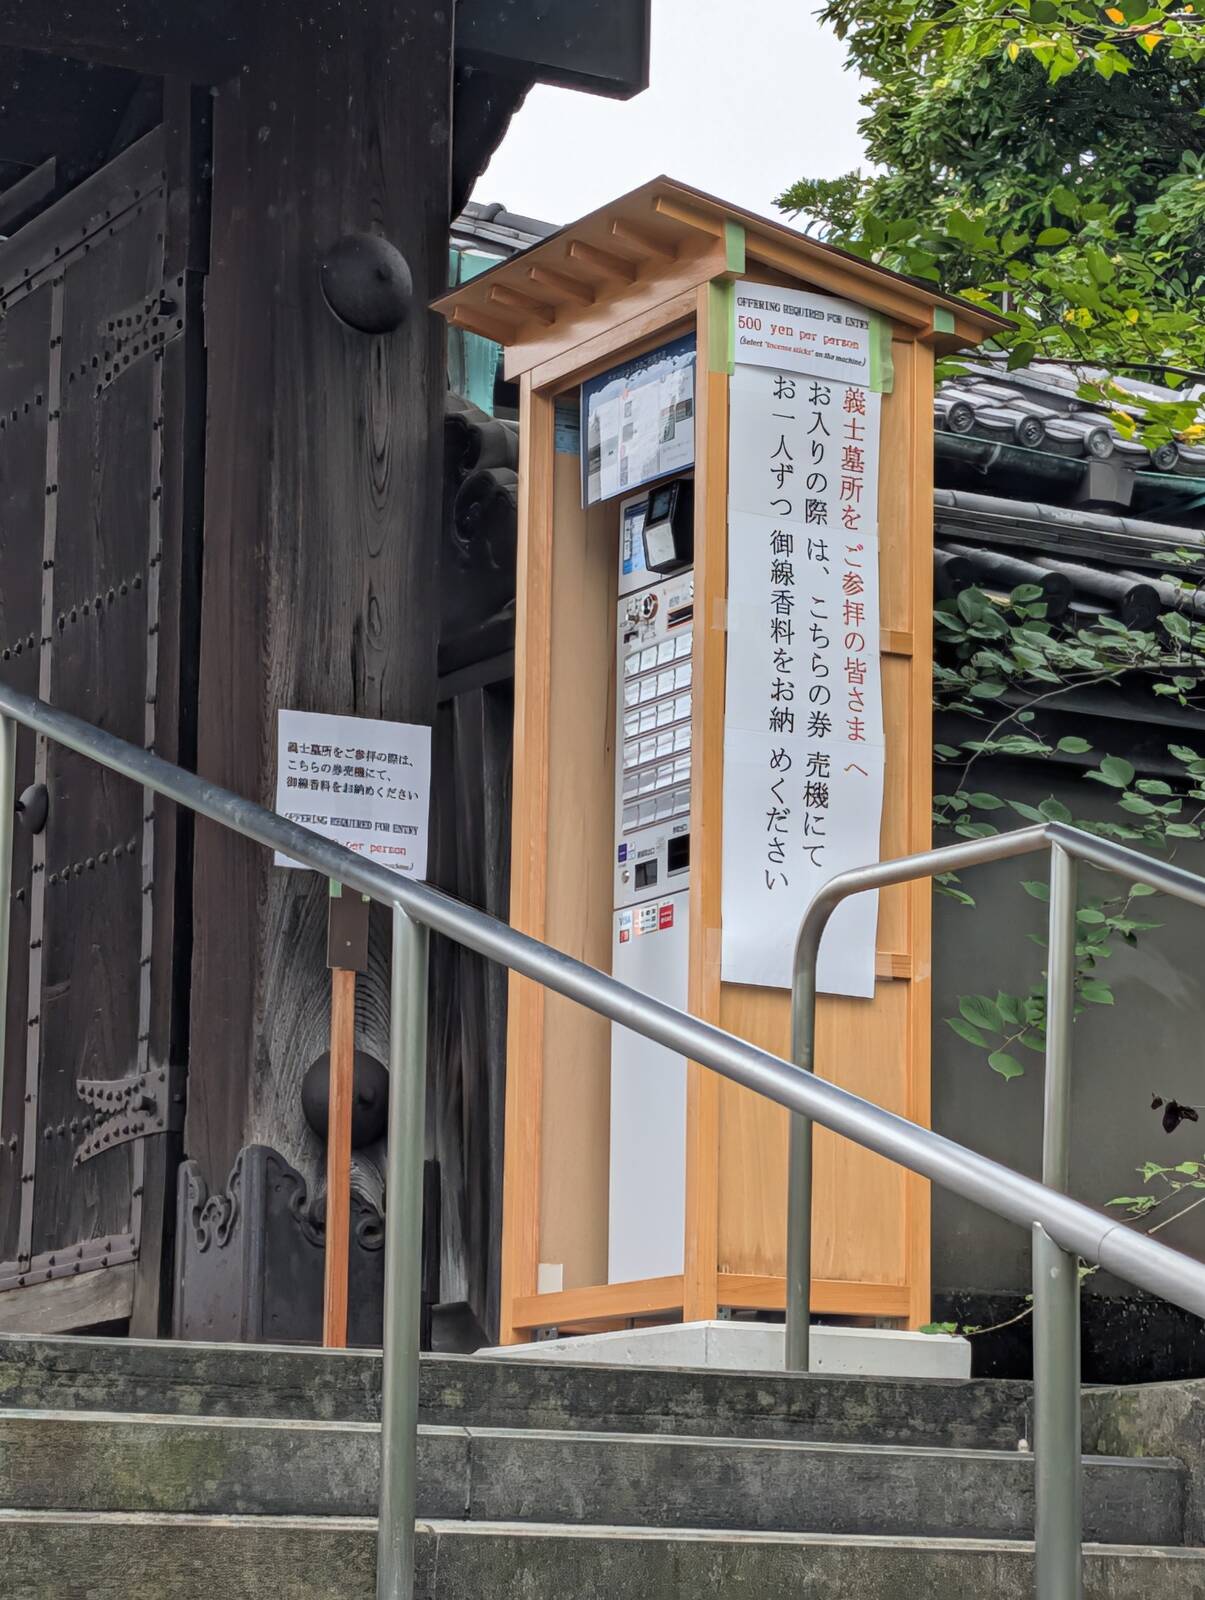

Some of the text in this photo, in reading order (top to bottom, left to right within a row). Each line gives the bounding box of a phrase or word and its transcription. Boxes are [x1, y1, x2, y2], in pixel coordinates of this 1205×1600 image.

[737, 297, 870, 330] OFFERING REQUIRED FOR ENTRY
[738, 315, 860, 350] 500 yen per person
[840, 386, 868, 777] 義士墓所をご参拝の皆さまへ
[764, 375, 796, 890] お一人ずつ御線香料をお納めください
[802, 381, 832, 868] お入りの際は、こちらの券売機にて
[287, 741, 414, 767] 義士墓所をご参拝の際は、
[288, 759, 391, 782] こちらの券売機にて、
[286, 776, 419, 801] 御線香料をお納めください
[330, 817, 372, 830] REQUIRED
[374, 822, 390, 833] FOR
[392, 823, 419, 836] ENTRY
[370, 844, 407, 856] person
